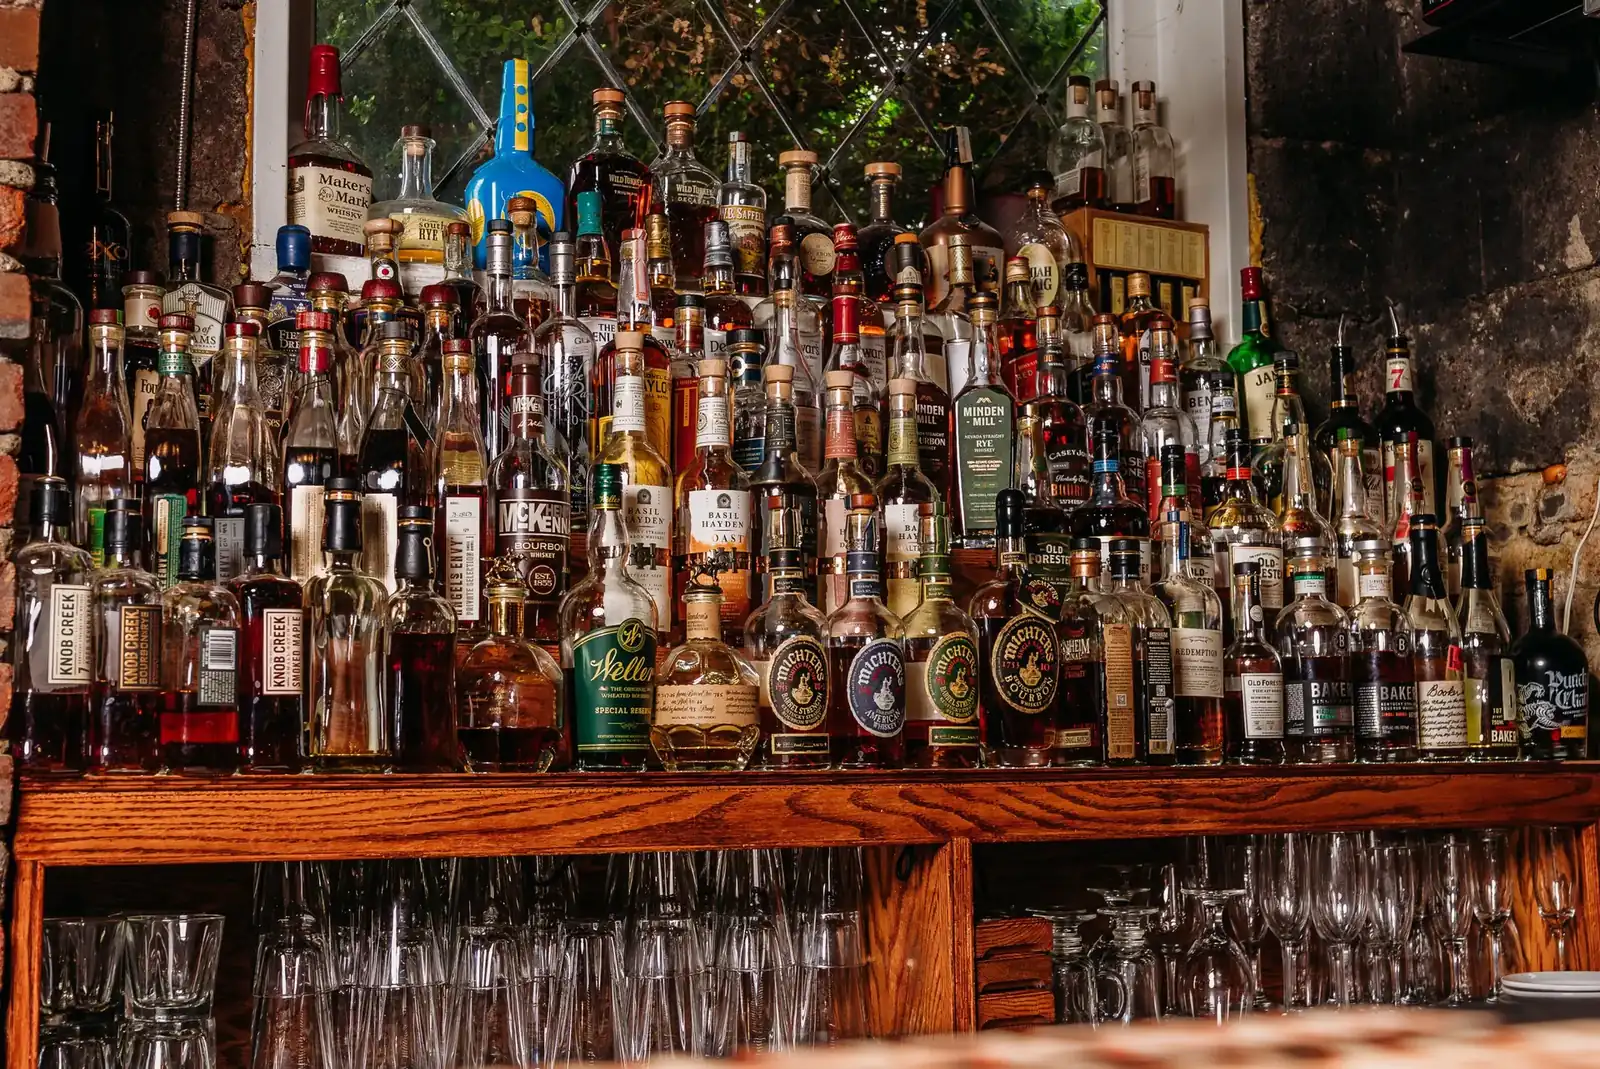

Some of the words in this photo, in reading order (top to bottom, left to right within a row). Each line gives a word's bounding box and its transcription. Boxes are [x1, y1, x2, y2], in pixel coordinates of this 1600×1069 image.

[318, 173, 371, 195] Maker's
[608, 173, 624, 183] WILD
[676, 183, 692, 193] WILD
[335, 190, 370, 209] Mark
[326, 206, 363, 220] WHISKY
[418, 228, 439, 241] RYE
[1030, 266, 1052, 281] IJAH
[201, 323, 212, 335] of
[597, 323, 616, 332] THE
[801, 343, 820, 355] war's
[862, 347, 885, 359] war's
[1391, 368, 1405, 389] 7
[643, 380, 667, 394] AYLO
[963, 406, 1005, 417] MINDEN
[972, 416, 996, 426] MILL
[975, 439, 994, 448] RYE
[1048, 449, 1075, 460] CASEY
[627, 507, 660, 515] BASIL
[708, 511, 739, 519] BASIL
[712, 534, 745, 544] OAST
[514, 542, 566, 552] BOURBON
[1045, 543, 1064, 554] OLD
[450, 539, 463, 570] ENVY
[465, 552, 475, 587] SELECTION
[534, 572, 551, 580] EST.
[465, 588, 474, 616] PRIVATE
[61, 594, 75, 636] CREEK
[124, 609, 140, 649] CREEK
[273, 616, 286, 654] CREEK
[292, 616, 301, 647] MAPLE
[1003, 625, 1055, 662] MICHTER'S
[1061, 638, 1091, 655] NHEIM
[1339, 634, 1345, 648] B
[1398, 639, 1406, 651] B
[60, 639, 74, 676] KNOB
[1175, 648, 1218, 657] REDEMPTION
[124, 651, 139, 684] KNOB
[273, 655, 286, 687] KNOB
[292, 650, 301, 687] SMOKED
[777, 648, 825, 681] MICHTER'S
[857, 651, 905, 687] MICHTER'S
[1004, 674, 1054, 702] BOURBON
[1261, 679, 1284, 687] FOREST
[594, 707, 628, 715] SPECIAL
[864, 709, 901, 724] AMERICAN
[872, 721, 898, 731] WHISKEY
